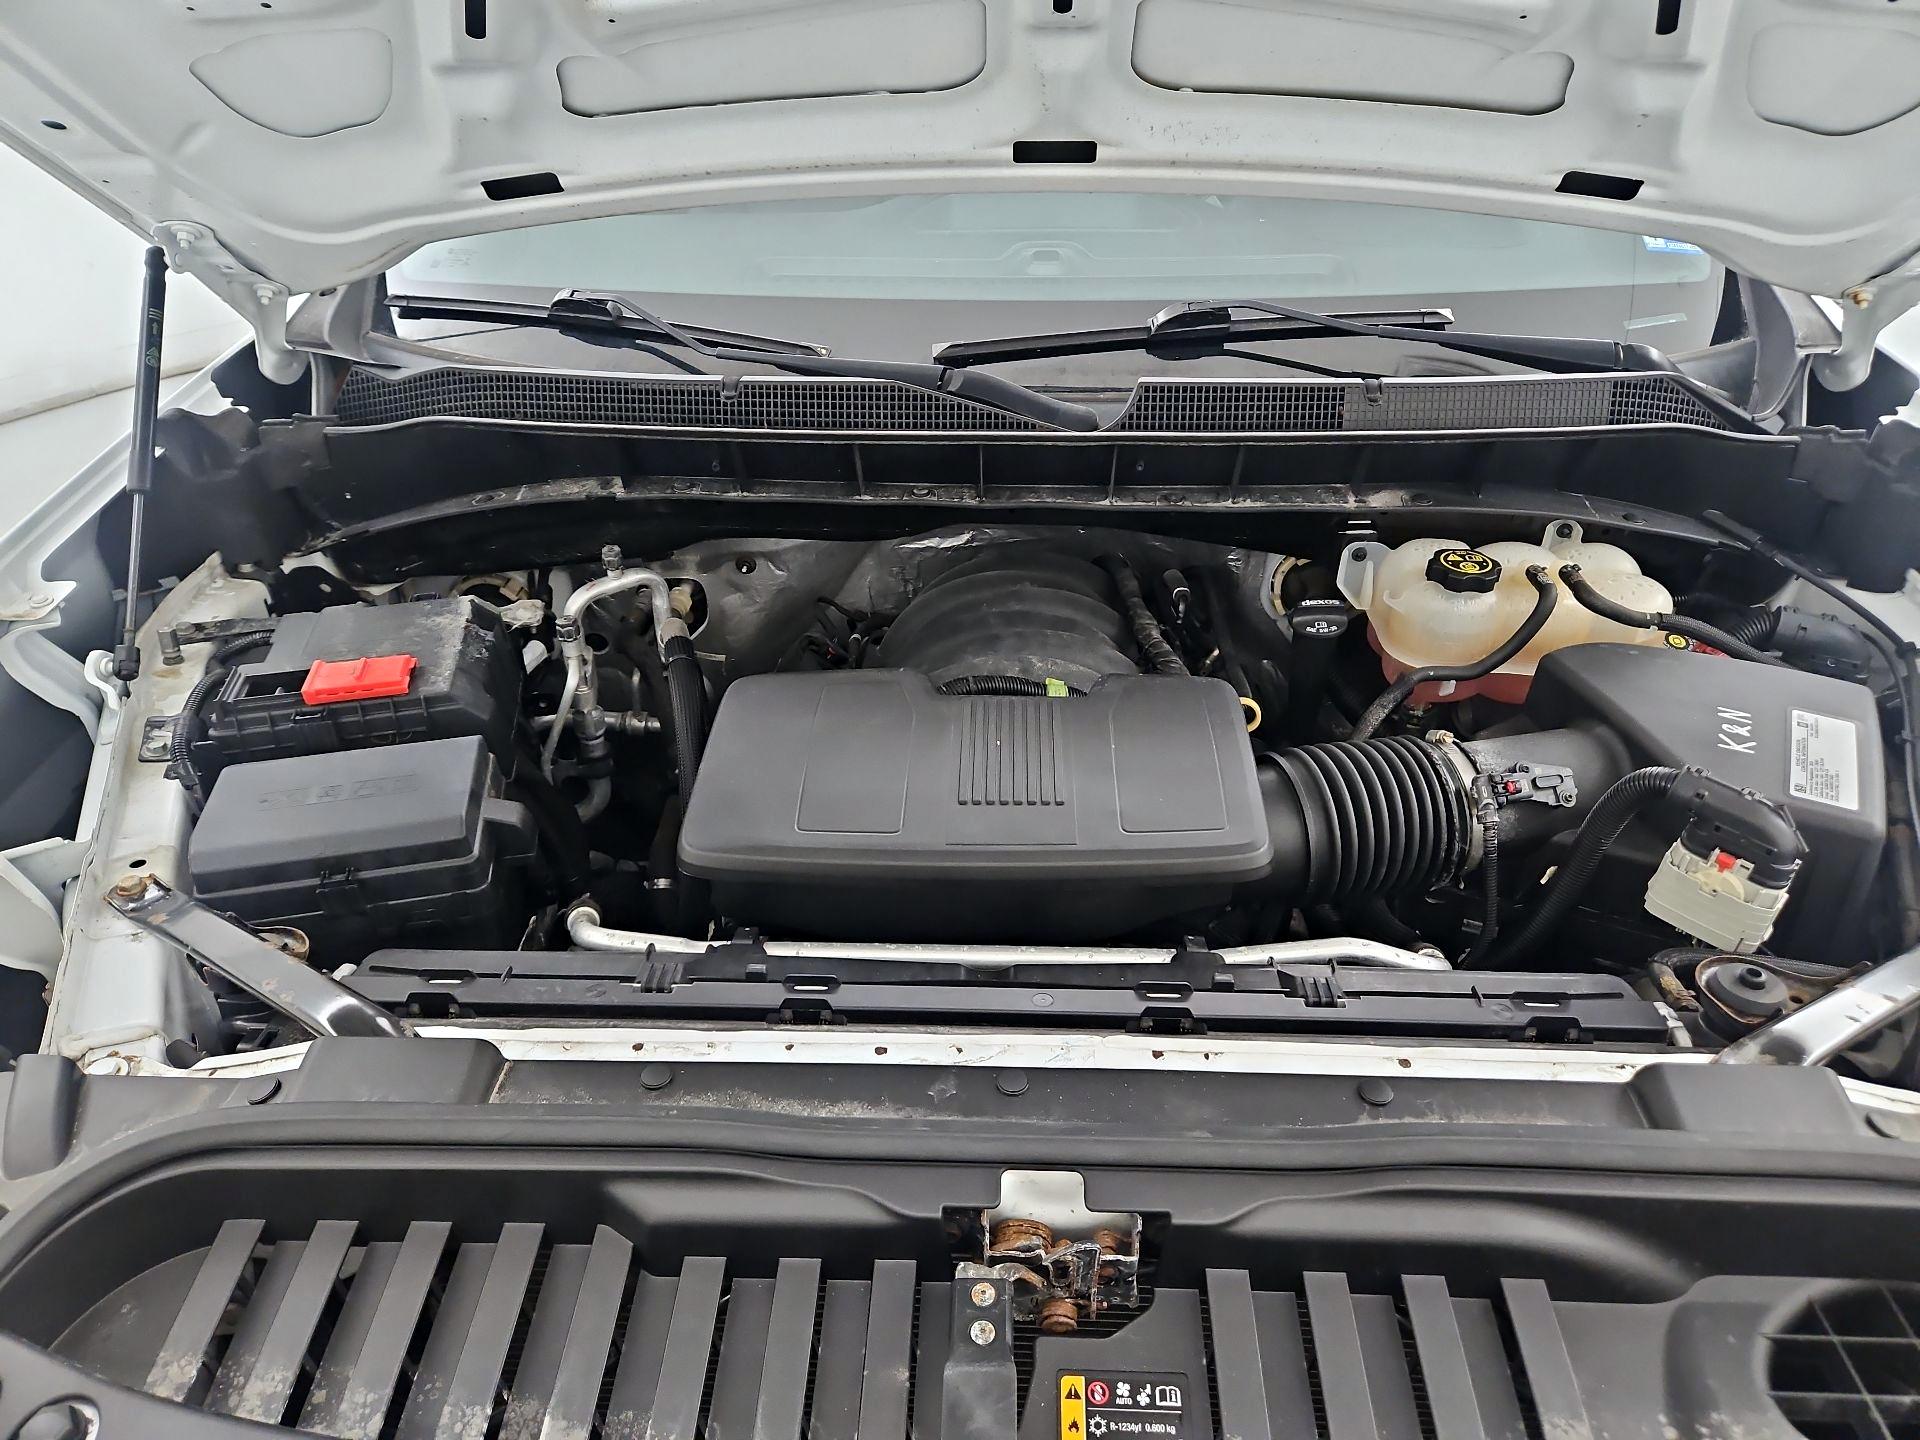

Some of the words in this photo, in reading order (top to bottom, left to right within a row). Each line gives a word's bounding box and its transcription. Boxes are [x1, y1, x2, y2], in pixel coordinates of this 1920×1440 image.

[1716, 706, 1757, 754] K&N
[1115, 1397, 1133, 1405] AUTO
[1110, 1422, 1141, 1433] R-1234yf
[1145, 1422, 1165, 1433] 0.600
[1166, 1423, 1176, 1434] kg
